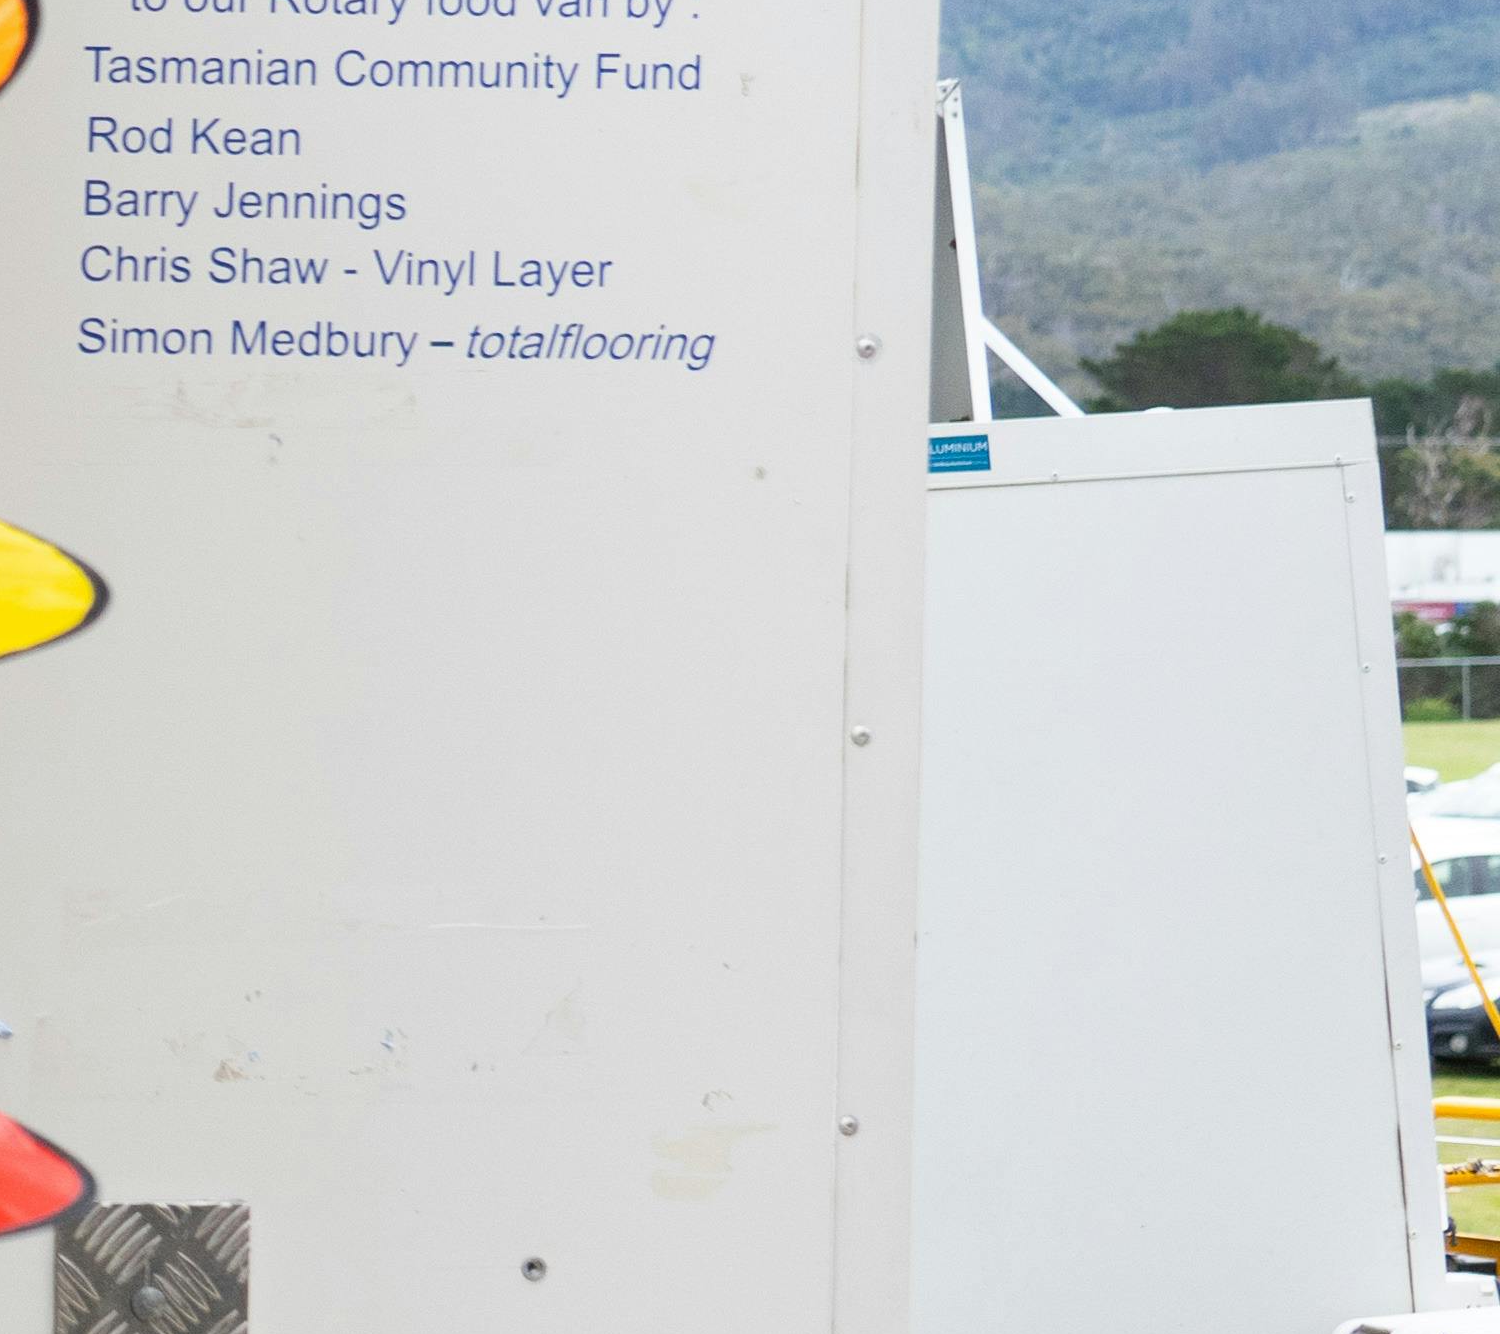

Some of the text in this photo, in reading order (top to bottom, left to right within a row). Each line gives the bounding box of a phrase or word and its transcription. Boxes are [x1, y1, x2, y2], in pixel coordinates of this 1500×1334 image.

[84, 46, 702, 98] Tasmanian Community Fund
[86, 116, 301, 157] Rod Kean
[83, 180, 408, 230] Barry Jennings
[80, 245, 612, 297] Chris Shaw Vinyl Layer
[77, 319, 715, 370] Simon Medbury totalflooring
[929, 442, 987, 454] LUMINIUM
